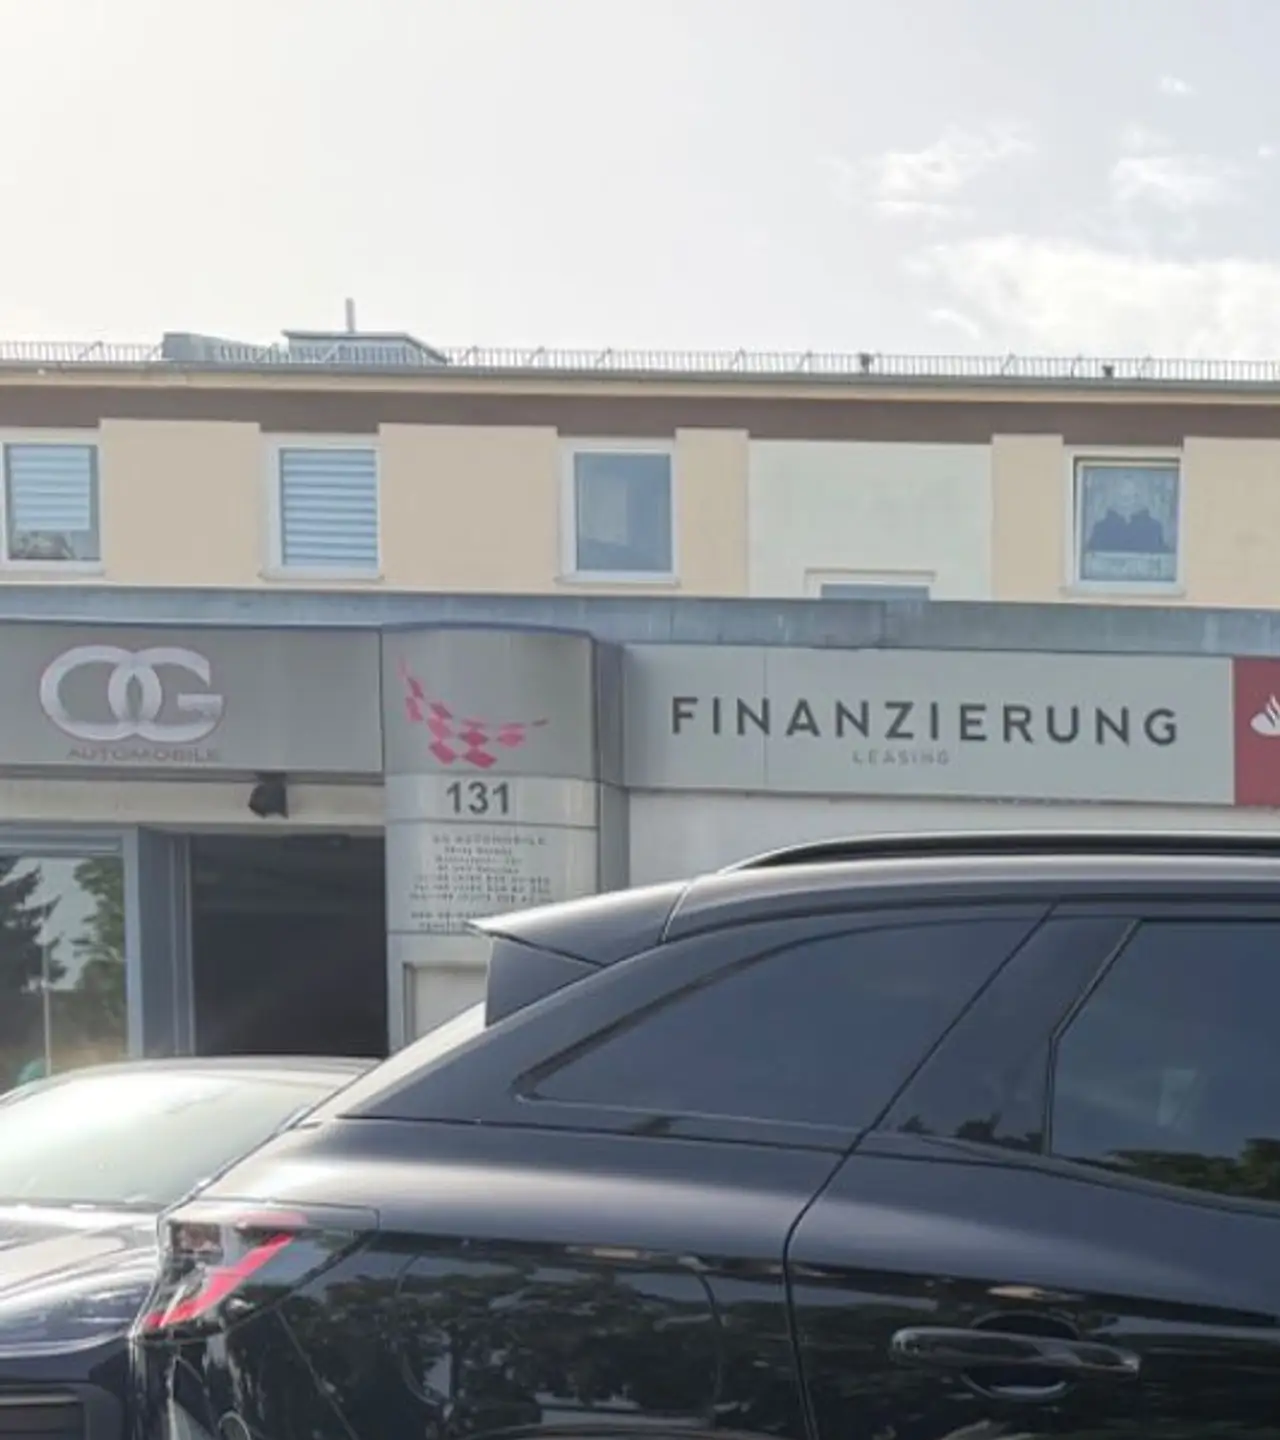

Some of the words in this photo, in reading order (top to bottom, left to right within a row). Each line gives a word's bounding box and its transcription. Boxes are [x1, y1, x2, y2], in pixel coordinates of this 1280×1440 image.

[671, 696, 1178, 746] FINANZIERUNG
[66, 747, 221, 763] AUTOMOBILE
[851, 749, 950, 765] LEASING
[446, 781, 510, 815] 131
